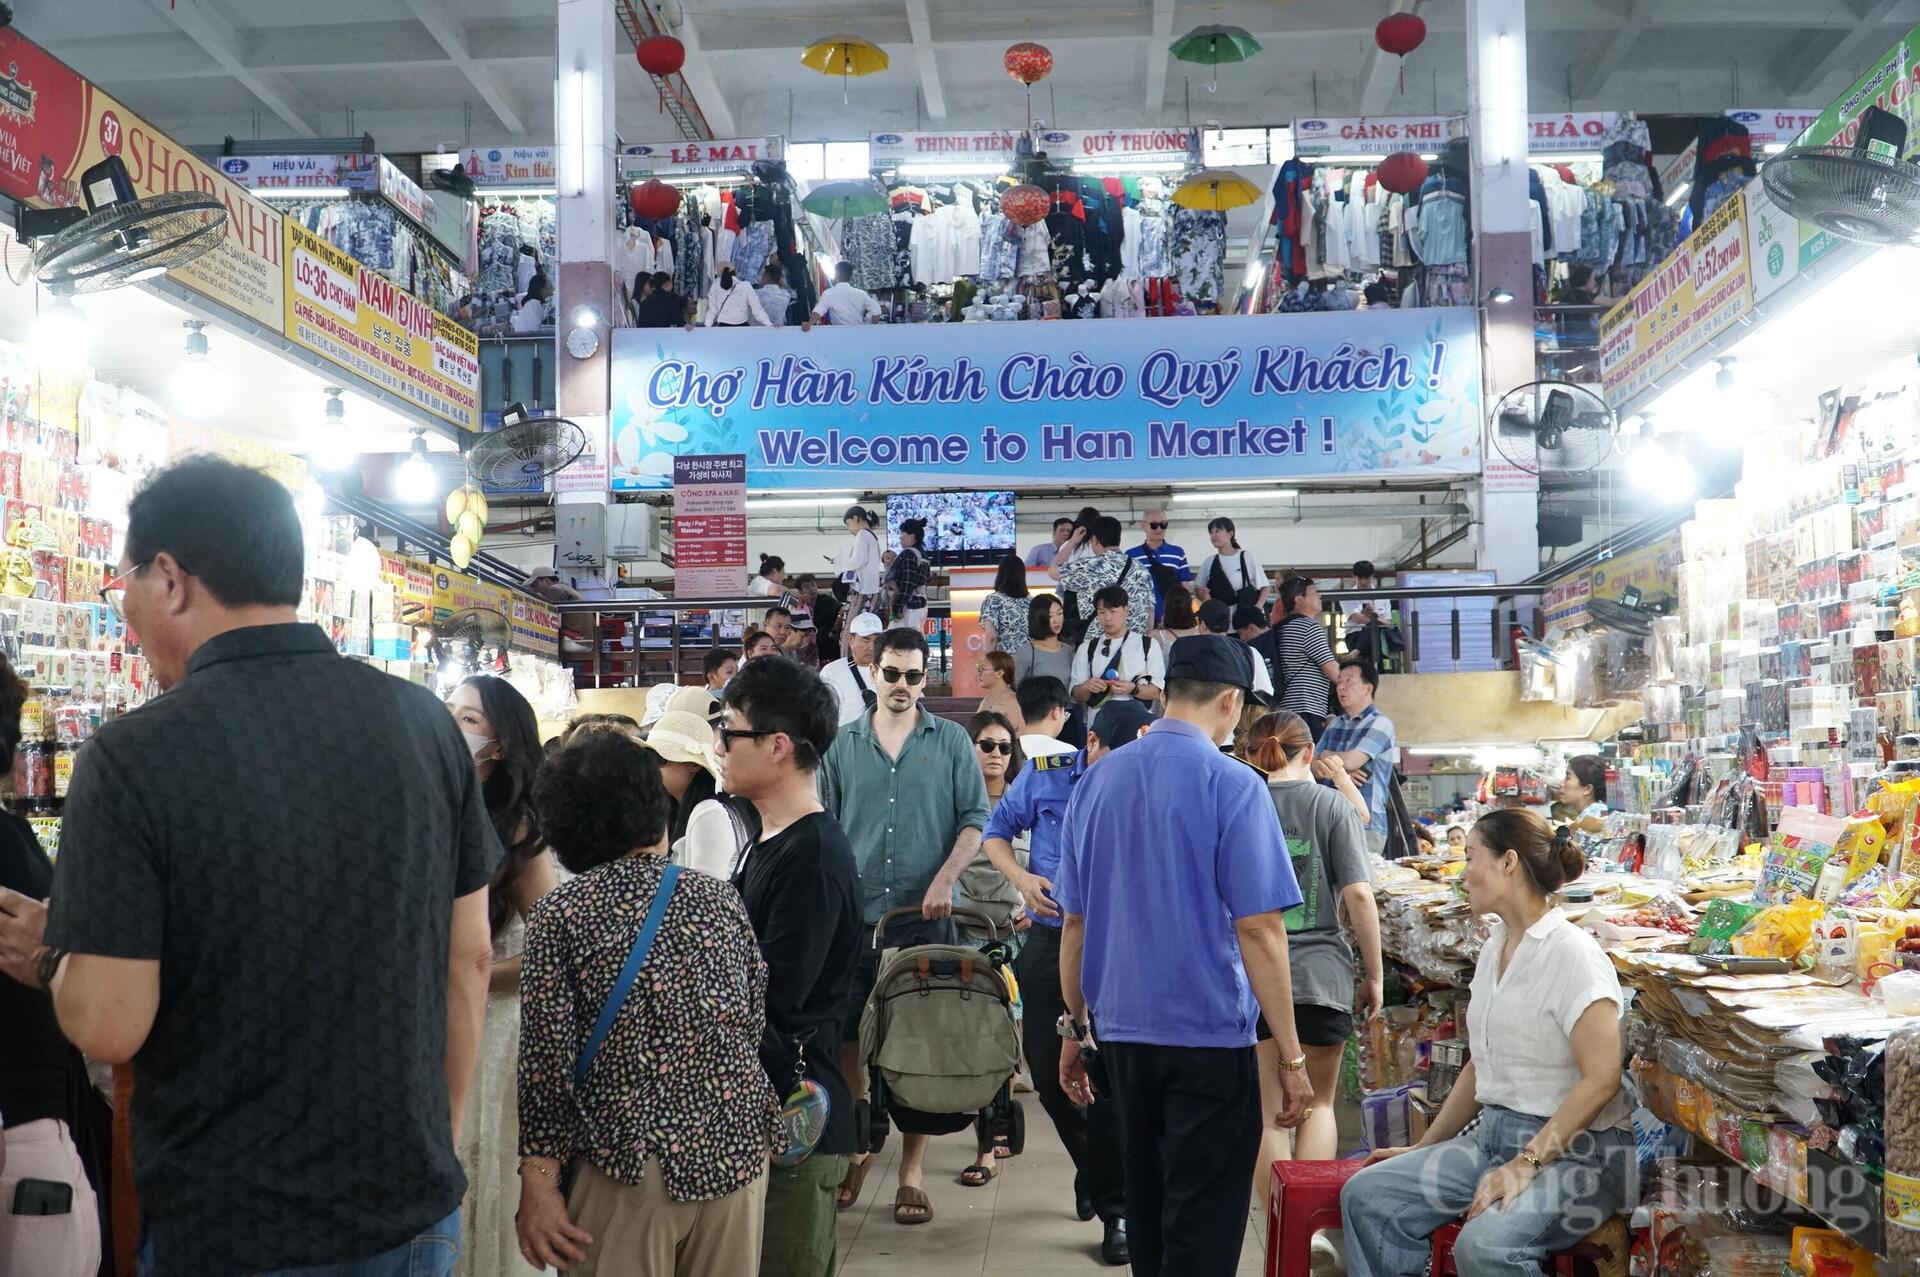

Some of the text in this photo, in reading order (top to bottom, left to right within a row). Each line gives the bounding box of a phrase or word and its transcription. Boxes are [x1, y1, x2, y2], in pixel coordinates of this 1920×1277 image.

[1405, 123, 1441, 139] NHI
[1528, 114, 1603, 138] HẢO
[513, 149, 533, 160] hiệu
[671, 143, 700, 164] LÊ
[709, 145, 757, 163] MAI
[915, 136, 969, 155] THỊNH
[272, 158, 316, 172] HIỆU VẢI
[505, 162, 528, 180] Kim
[257, 176, 289, 188] KIM
[103, 116, 119, 147] 37
[224, 186, 281, 268] NHI
[296, 256, 328, 301] LÔ:36
[359, 267, 433, 340] NAM ĐỊNH
[647, 341, 1448, 418] Chợ Hàn Kính Chào Quý Khách !
[757, 415, 1337, 467] Welcome to Han Market !
[676, 461, 691, 470] 다낭
[691, 460, 713, 470] 한시장
[688, 469, 732, 480] 가성비 마사지
